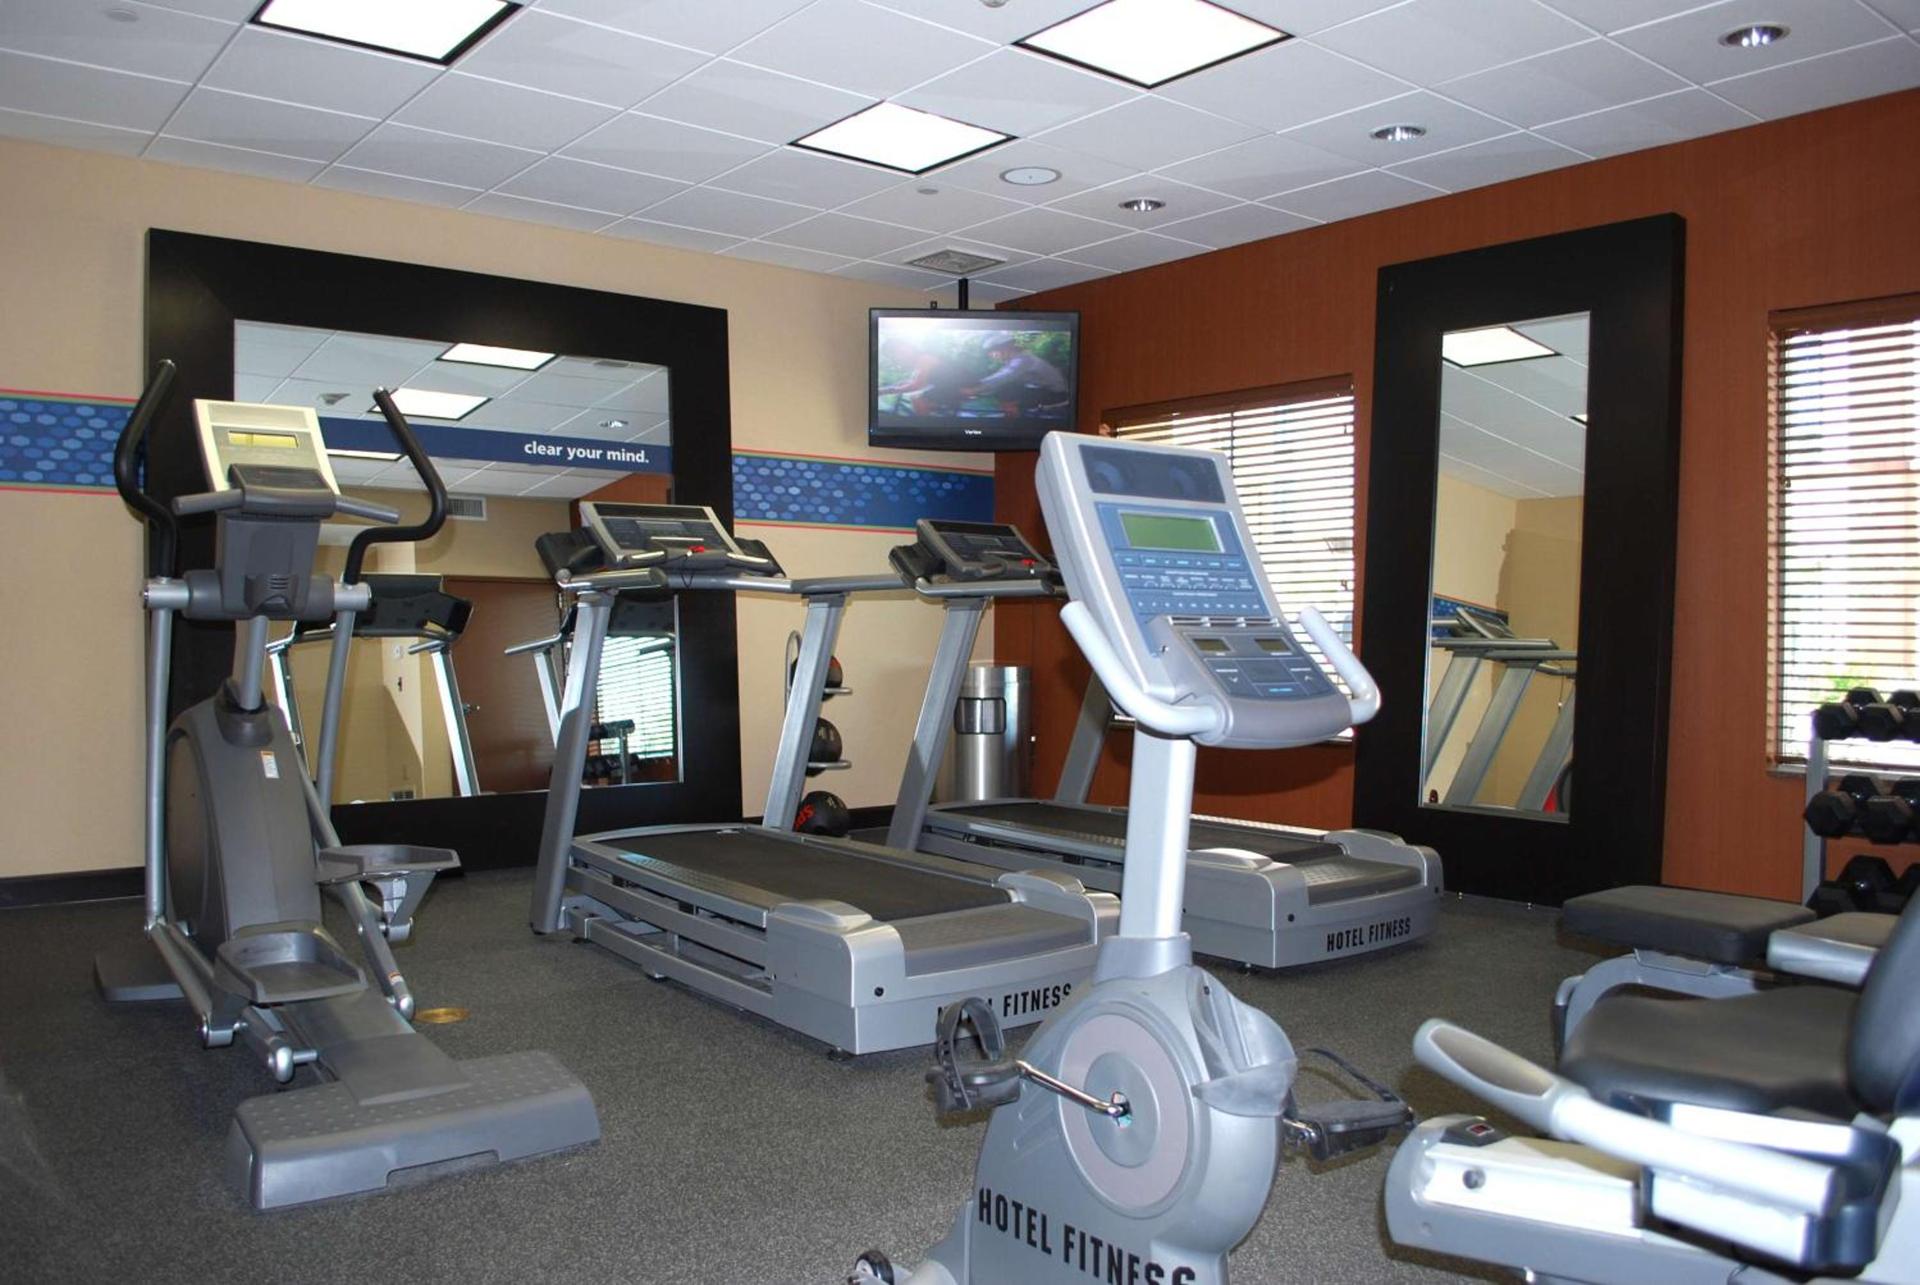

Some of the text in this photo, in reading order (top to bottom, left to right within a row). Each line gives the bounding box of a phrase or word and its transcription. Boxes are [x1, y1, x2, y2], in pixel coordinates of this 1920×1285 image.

[524, 441, 650, 463] clear your mind.
[1327, 917, 1411, 952] HOTEL FITNESS
[1003, 983, 1072, 1017] FITNESS
[979, 1187, 1052, 1255] HOTEL
